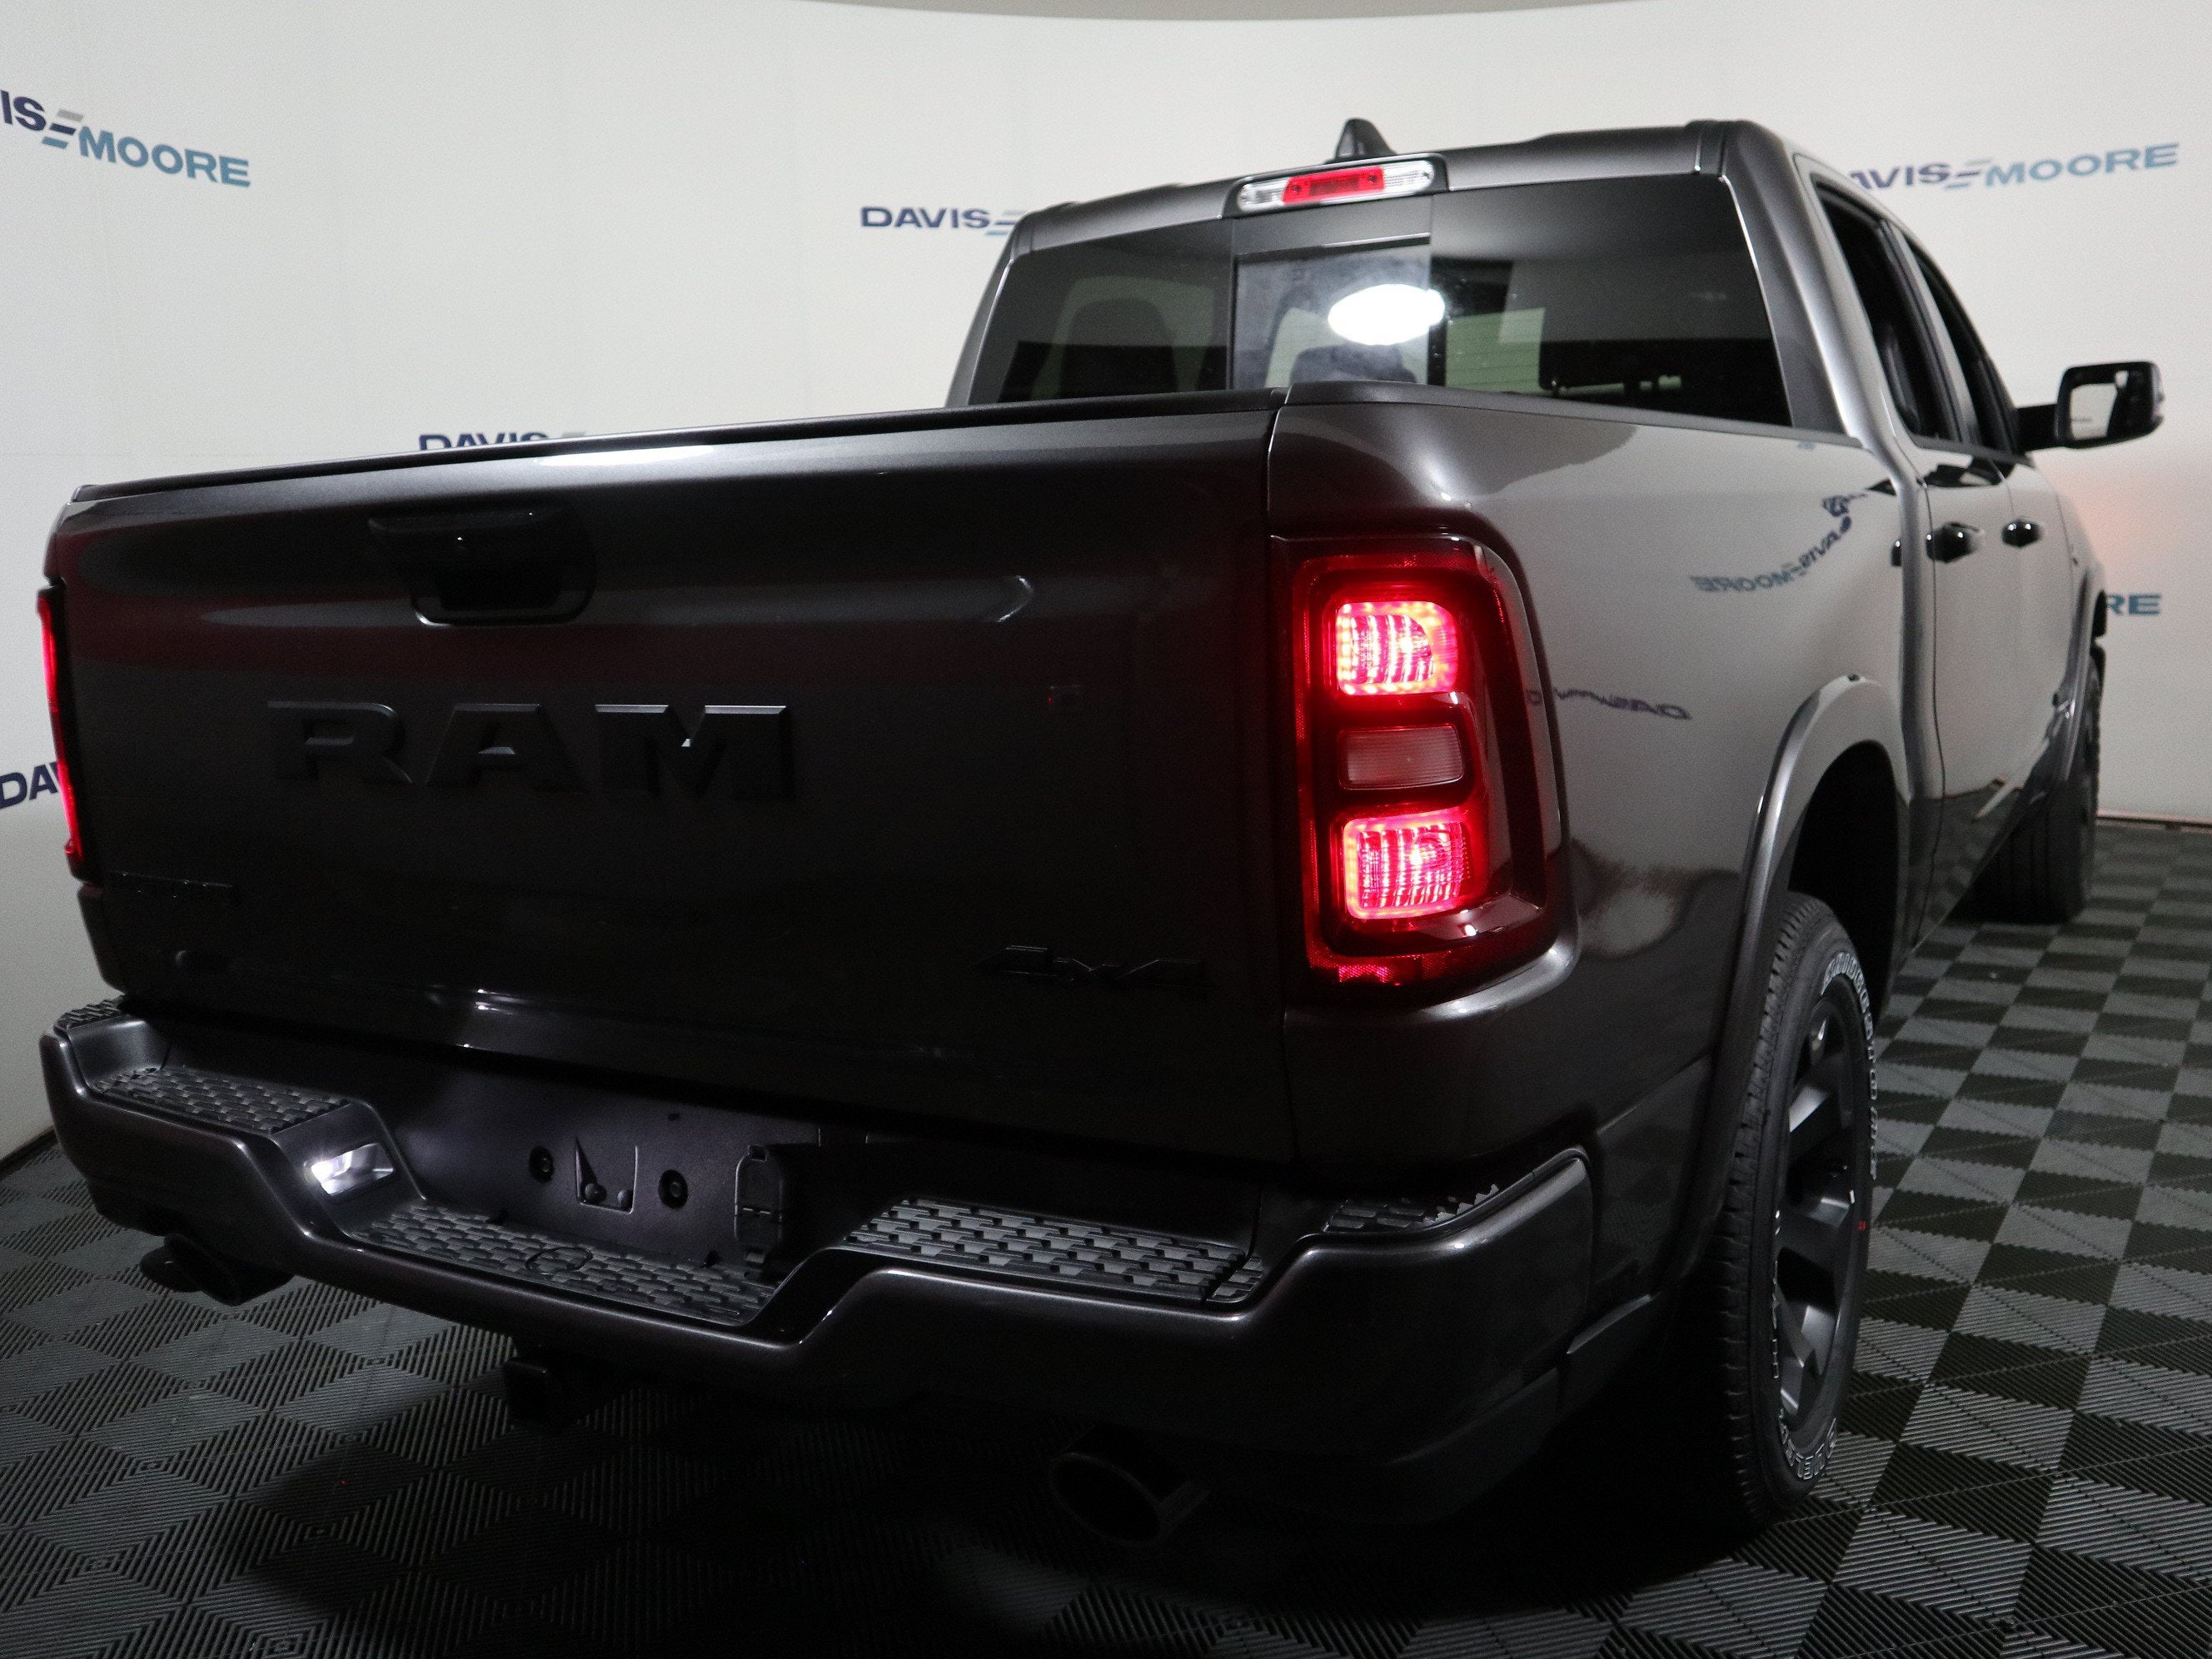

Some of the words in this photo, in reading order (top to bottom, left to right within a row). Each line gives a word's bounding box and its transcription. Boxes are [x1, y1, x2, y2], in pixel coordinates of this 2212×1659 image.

[78, 126, 251, 187] MOORE
[1985, 142, 2179, 187] MOORE
[861, 207, 990, 228] DAVIS
[267, 700, 795, 802] RAM
[0, 761, 58, 810] DA
